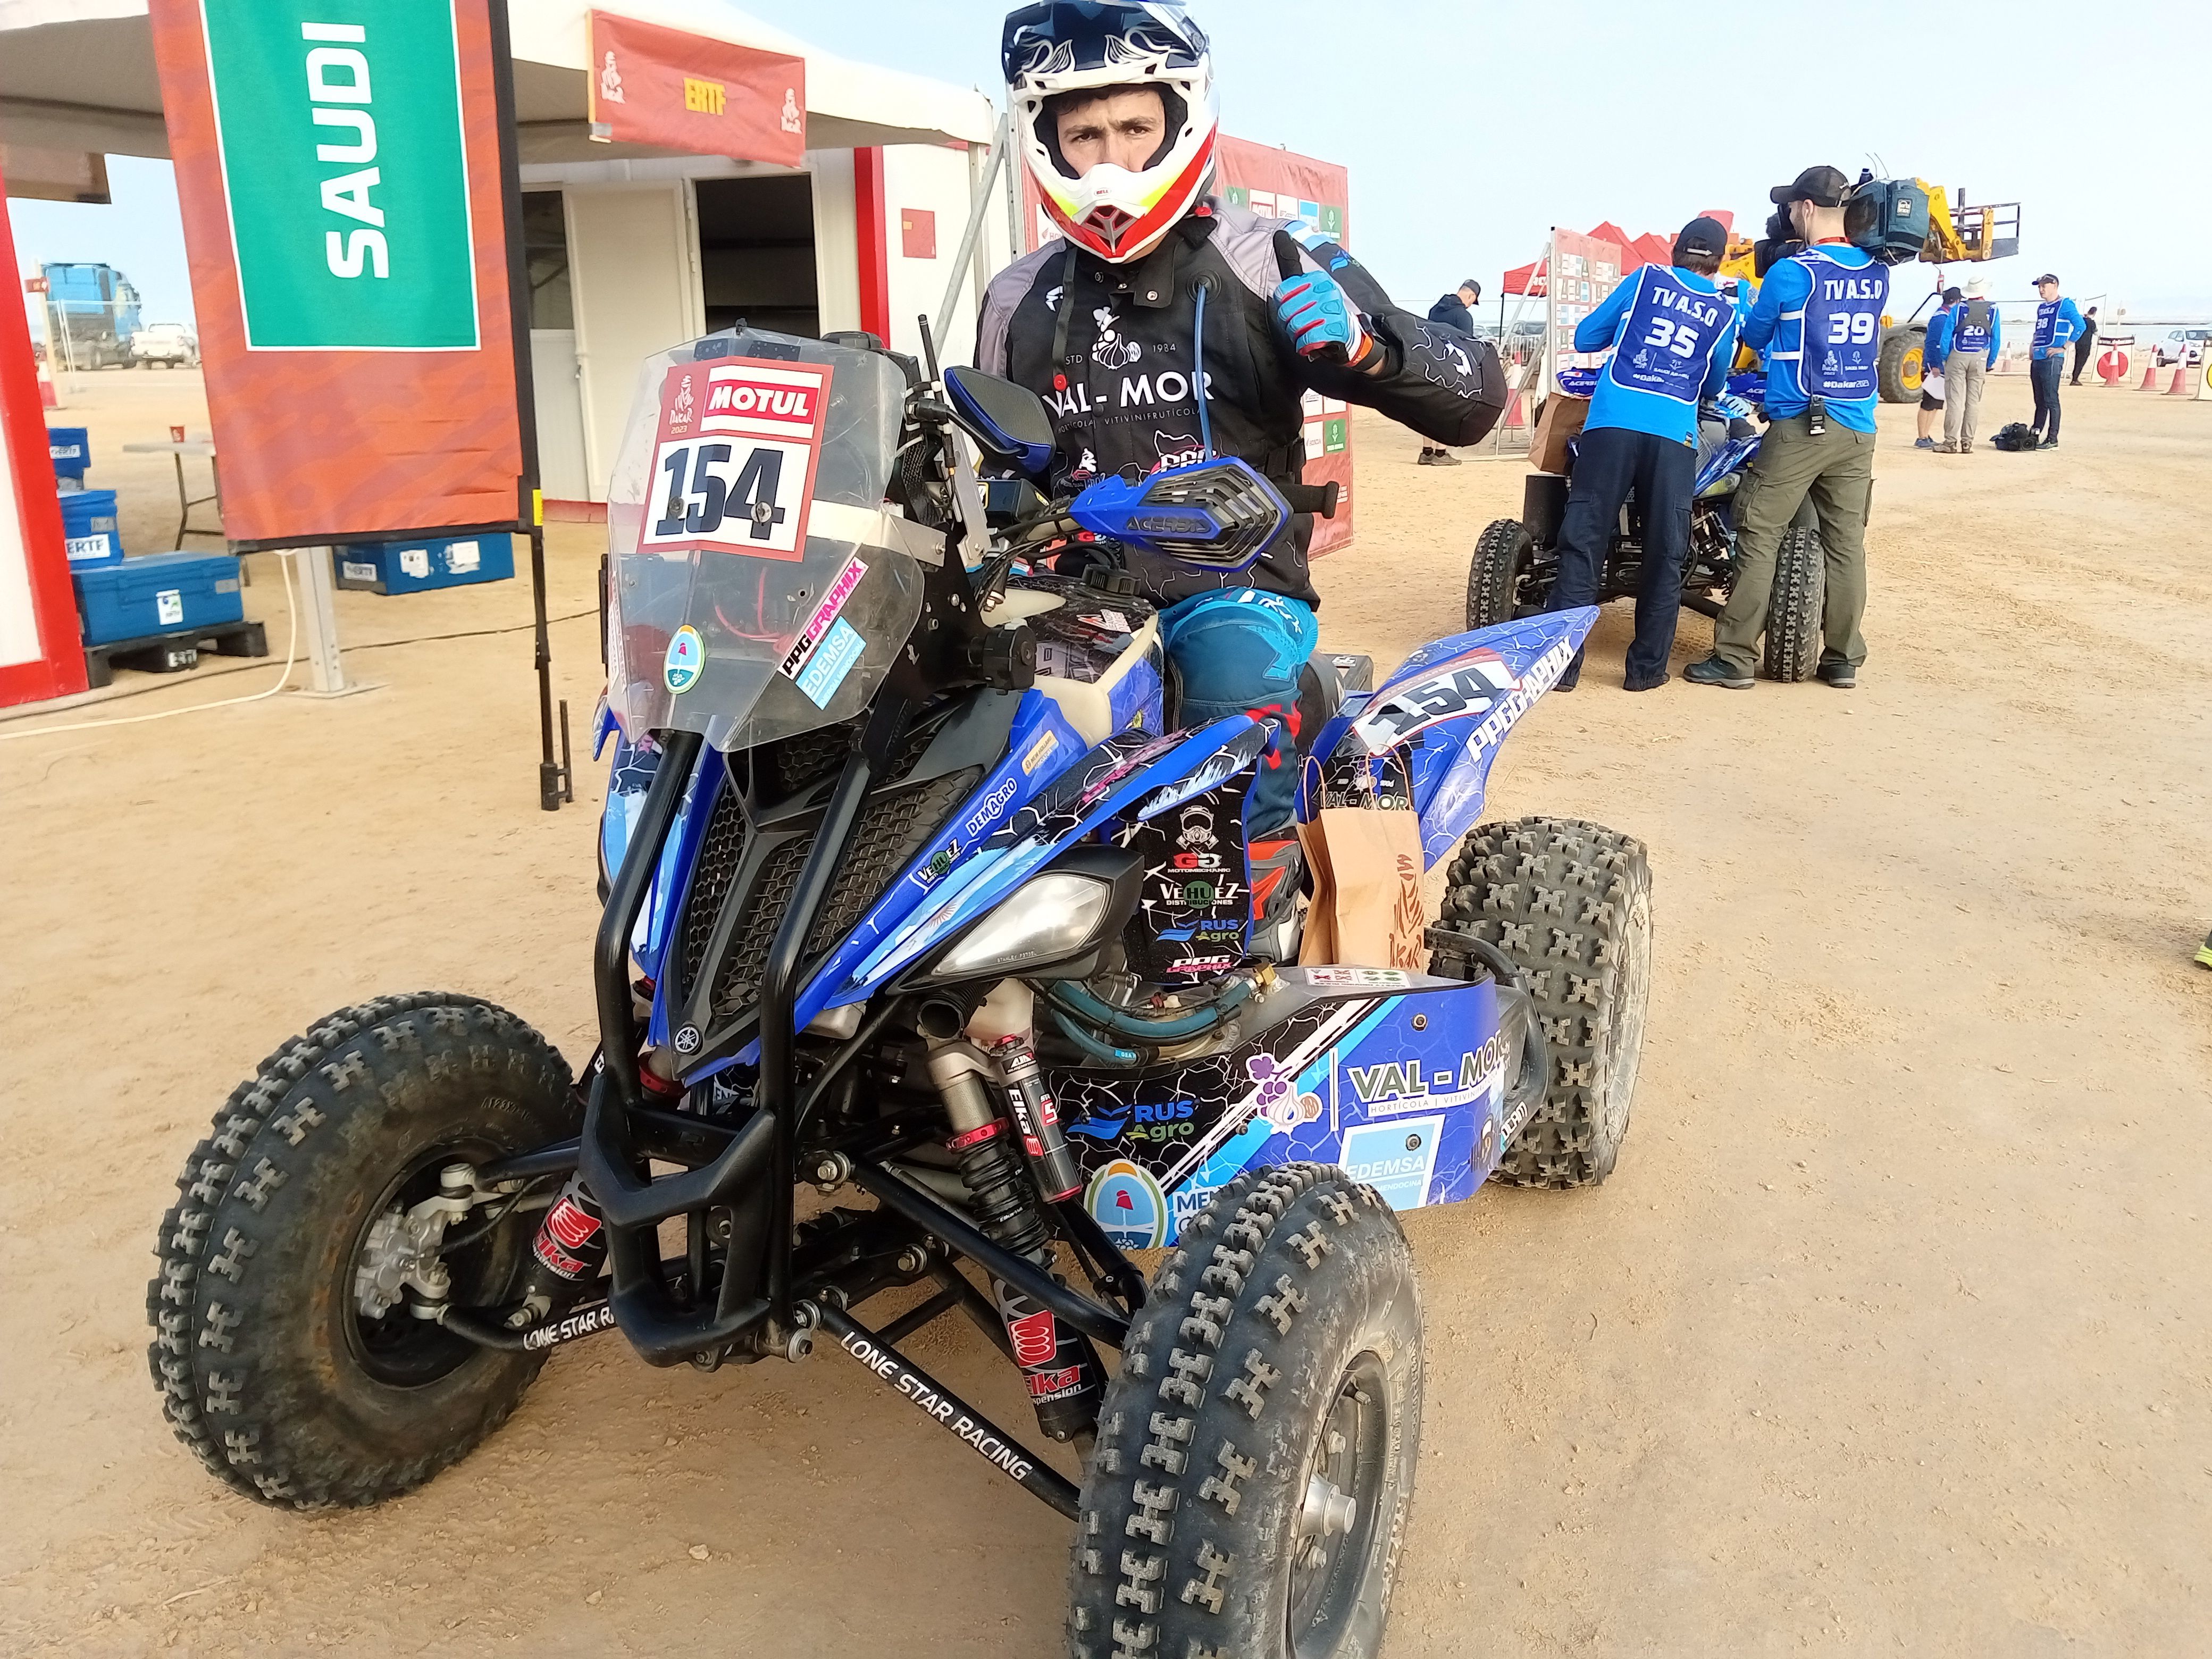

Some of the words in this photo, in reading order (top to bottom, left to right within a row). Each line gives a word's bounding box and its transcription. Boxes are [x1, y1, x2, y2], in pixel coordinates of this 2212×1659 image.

[683, 77, 726, 116] ERTF
[301, 22, 389, 278] SAUDI
[1824, 279, 1845, 300] TV
[1652, 286, 1677, 307] TV
[1674, 296, 1719, 328] A.S.O
[1644, 317, 1700, 358] 35
[1828, 312, 1875, 344] 39
[2036, 317, 2049, 330] 38
[1152, 343, 1176, 353] 1984
[708, 386, 809, 417] MOTUL
[669, 407, 693, 425] DAKAR
[670, 425, 688, 435] 2023
[655, 444, 785, 540] 154
[67, 538, 104, 554] ERTF
[801, 625, 854, 698] EDEMSA
[967, 778, 1017, 836] DEMAGRO
[1196, 931, 1239, 942] Agro
[1201, 919, 1239, 931] RUS
[1171, 954, 1231, 968] PPG
[1347, 1060, 1429, 1103] VAL
[1008, 1089, 1033, 1135] Elka
[1134, 1100, 1193, 1122] RUS
[1371, 1099, 1429, 1114] HORTÍCOLA
[1126, 1122, 1194, 1143] Agro
[1346, 1155, 1425, 1181] EDEMSA
[523, 1323, 560, 1351] LONE
[560, 1311, 599, 1339] STAR
[841, 1331, 900, 1380] LONE
[893, 1373, 954, 1423] STAR
[950, 1415, 1033, 1481] RACING
